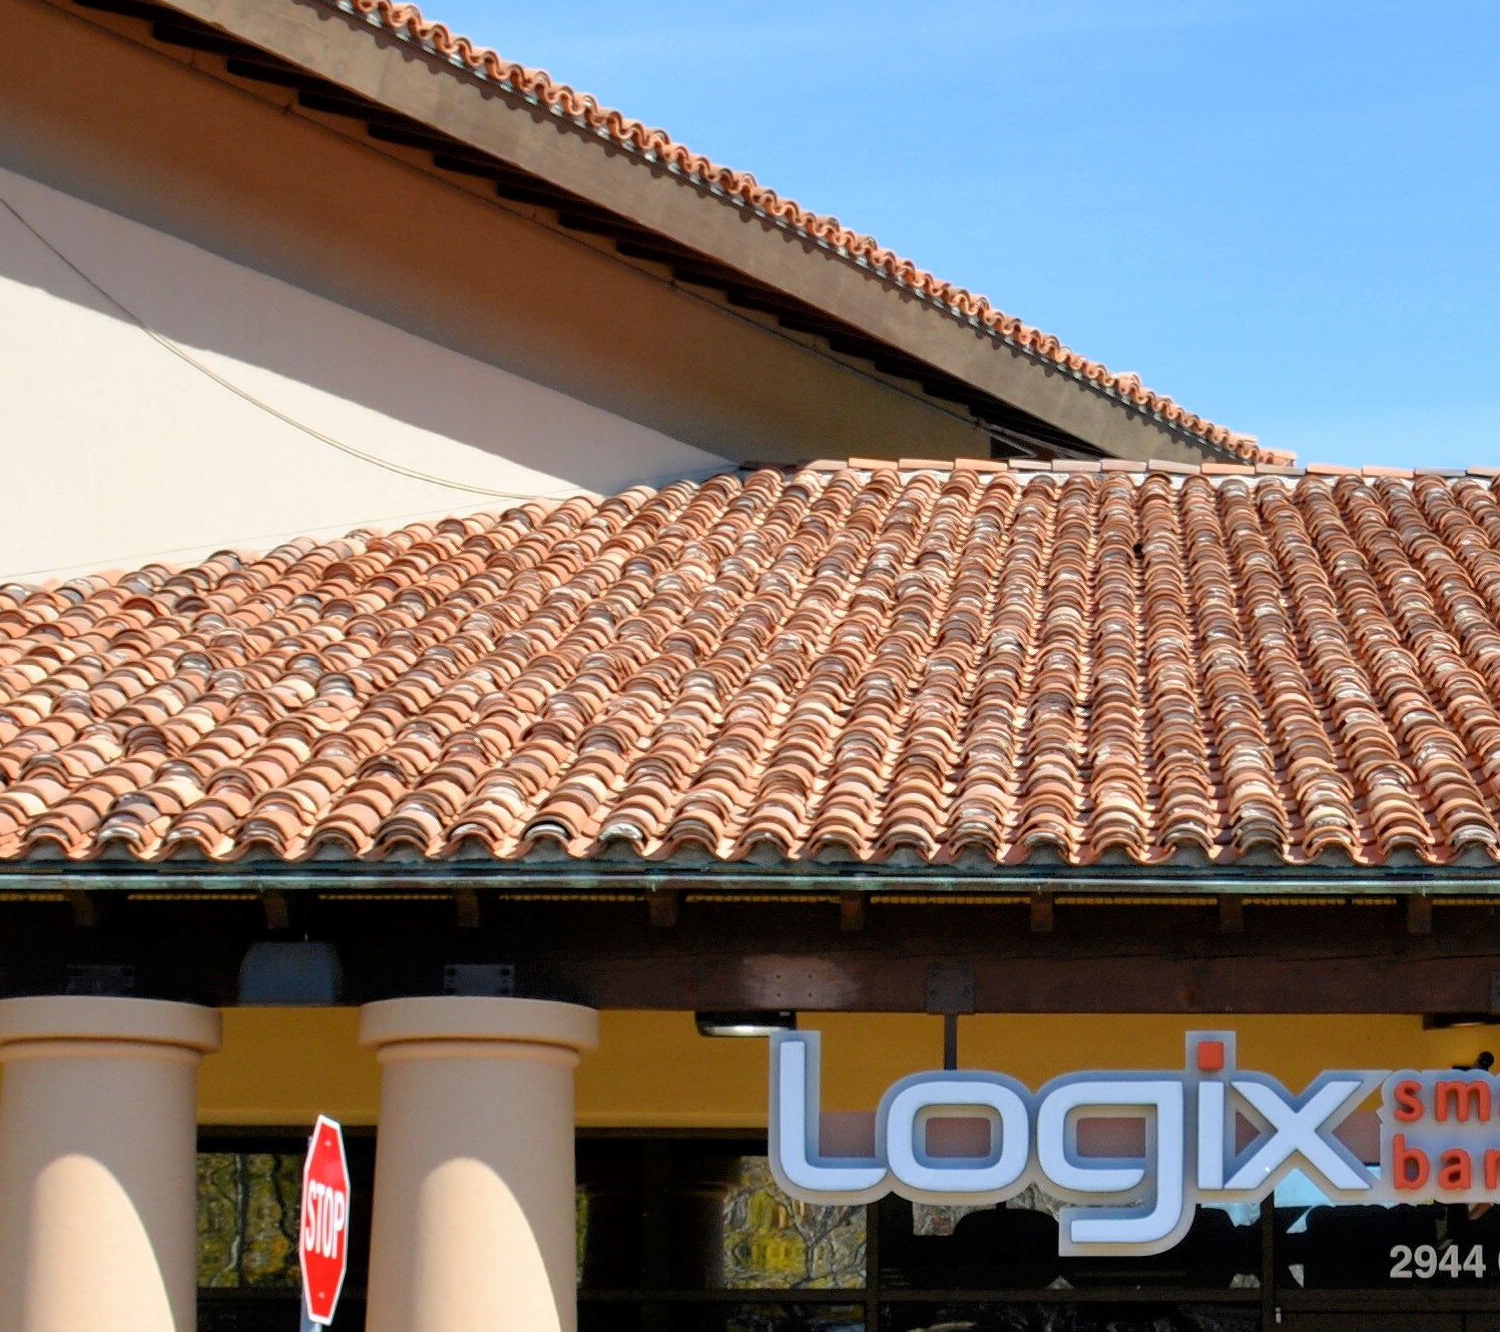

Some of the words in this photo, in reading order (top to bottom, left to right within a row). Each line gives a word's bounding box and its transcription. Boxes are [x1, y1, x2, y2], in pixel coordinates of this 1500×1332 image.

[778, 1039, 1374, 1246] Logix
[305, 1179, 346, 1260] STOP
[1389, 1244, 1487, 1279] 2944
